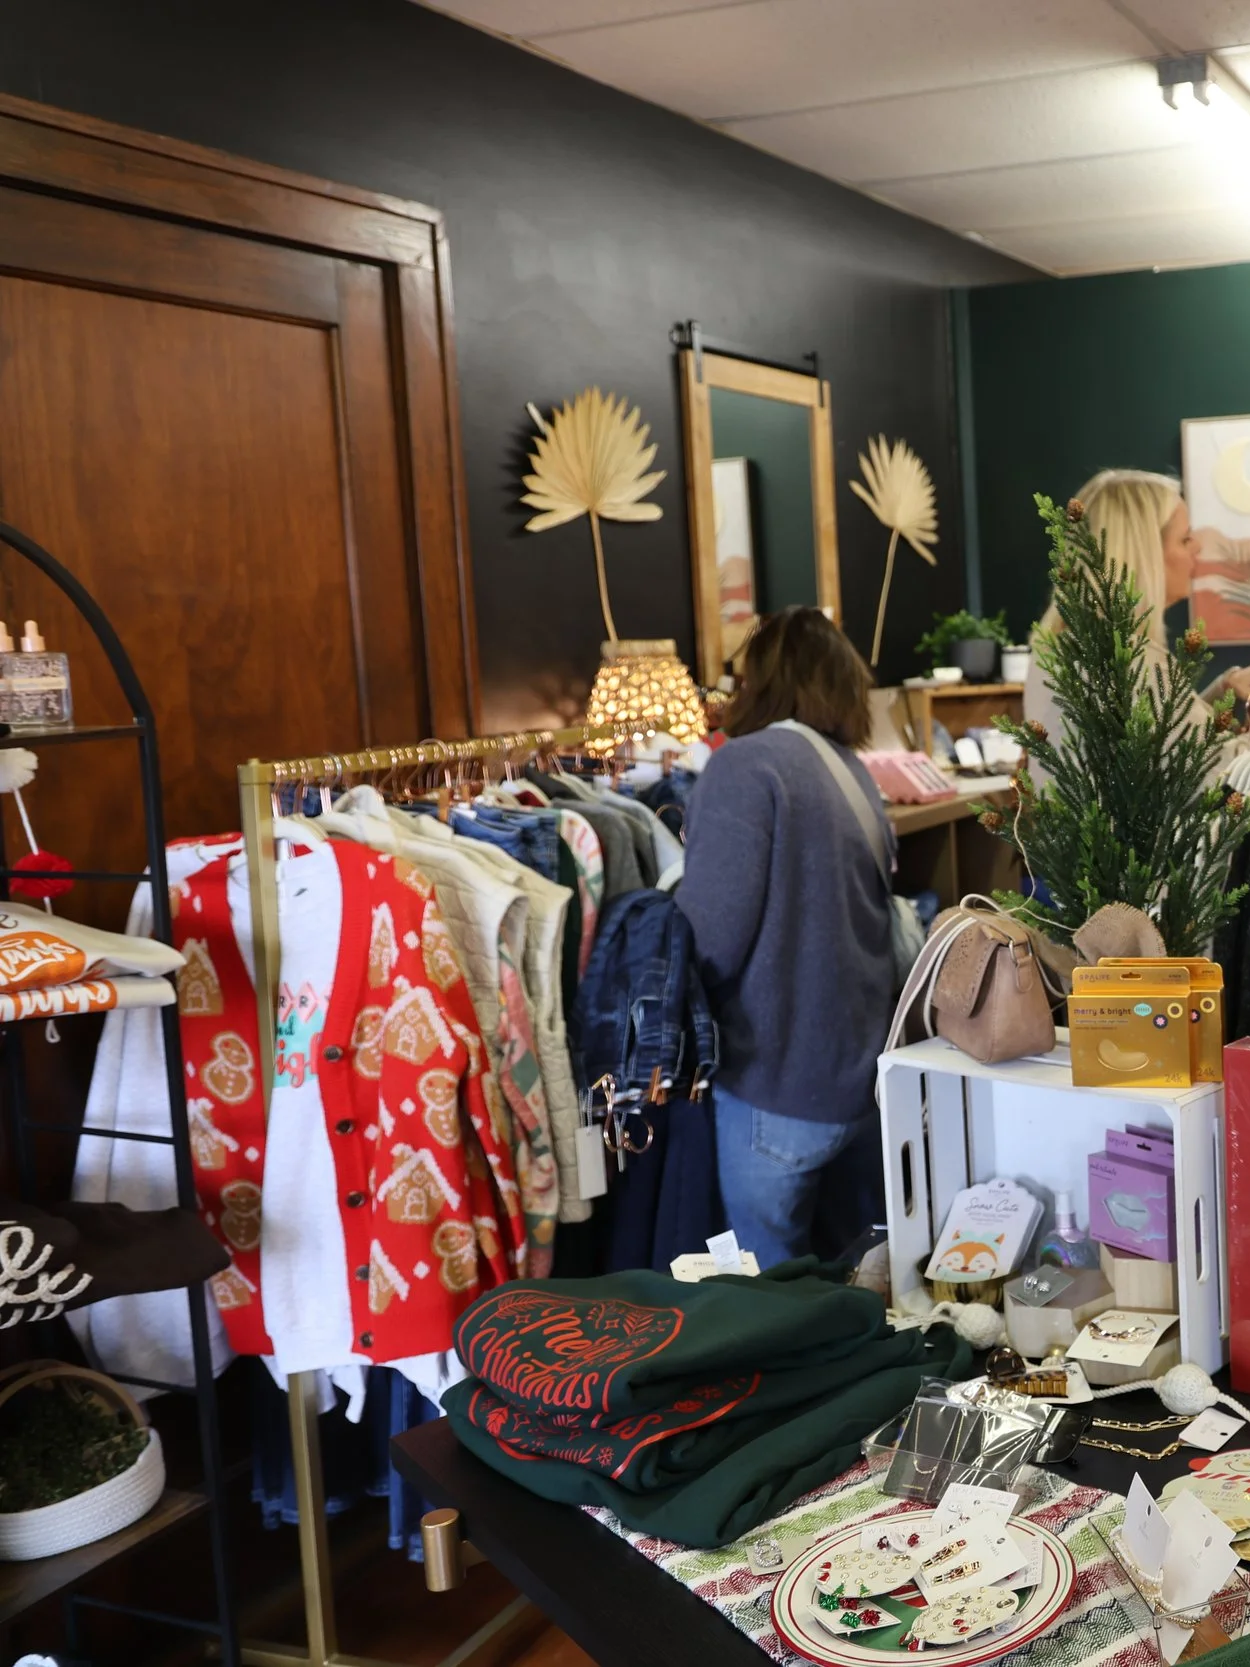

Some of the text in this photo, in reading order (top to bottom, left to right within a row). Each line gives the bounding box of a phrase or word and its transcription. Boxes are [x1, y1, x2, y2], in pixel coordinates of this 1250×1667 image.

[1074, 1008, 1097, 1016] merry
[1099, 1007, 1105, 1015] &
[1107, 1007, 1132, 1016] bright
[469, 1327, 599, 1409] Christmas
